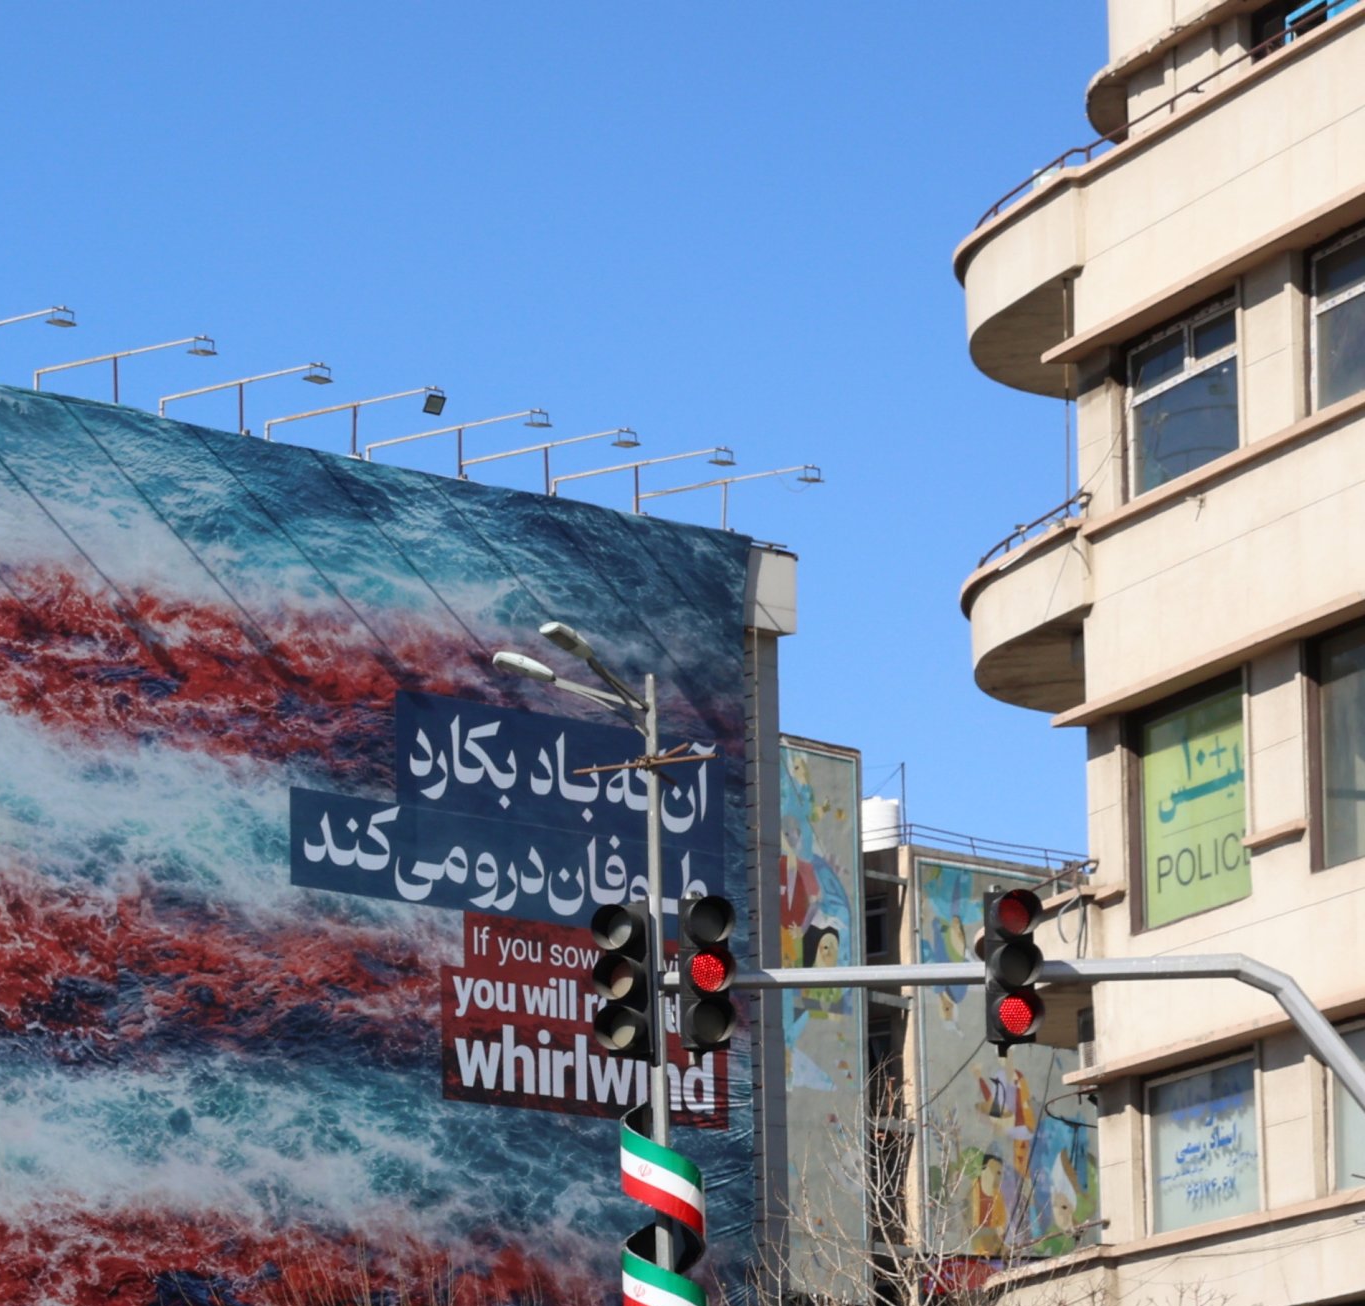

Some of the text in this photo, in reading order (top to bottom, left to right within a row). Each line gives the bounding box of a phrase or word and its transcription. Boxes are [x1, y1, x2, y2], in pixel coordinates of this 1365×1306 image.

[409, 714, 518, 810] بکارد
[530, 731, 601, 822] باد
[660, 741, 717, 833] آن
[1158, 740, 1245, 824] لیس
[469, 846, 546, 911] درو
[472, 926, 600, 970] If you sow
[452, 974, 516, 1018] you
[522, 977, 577, 1021] will
